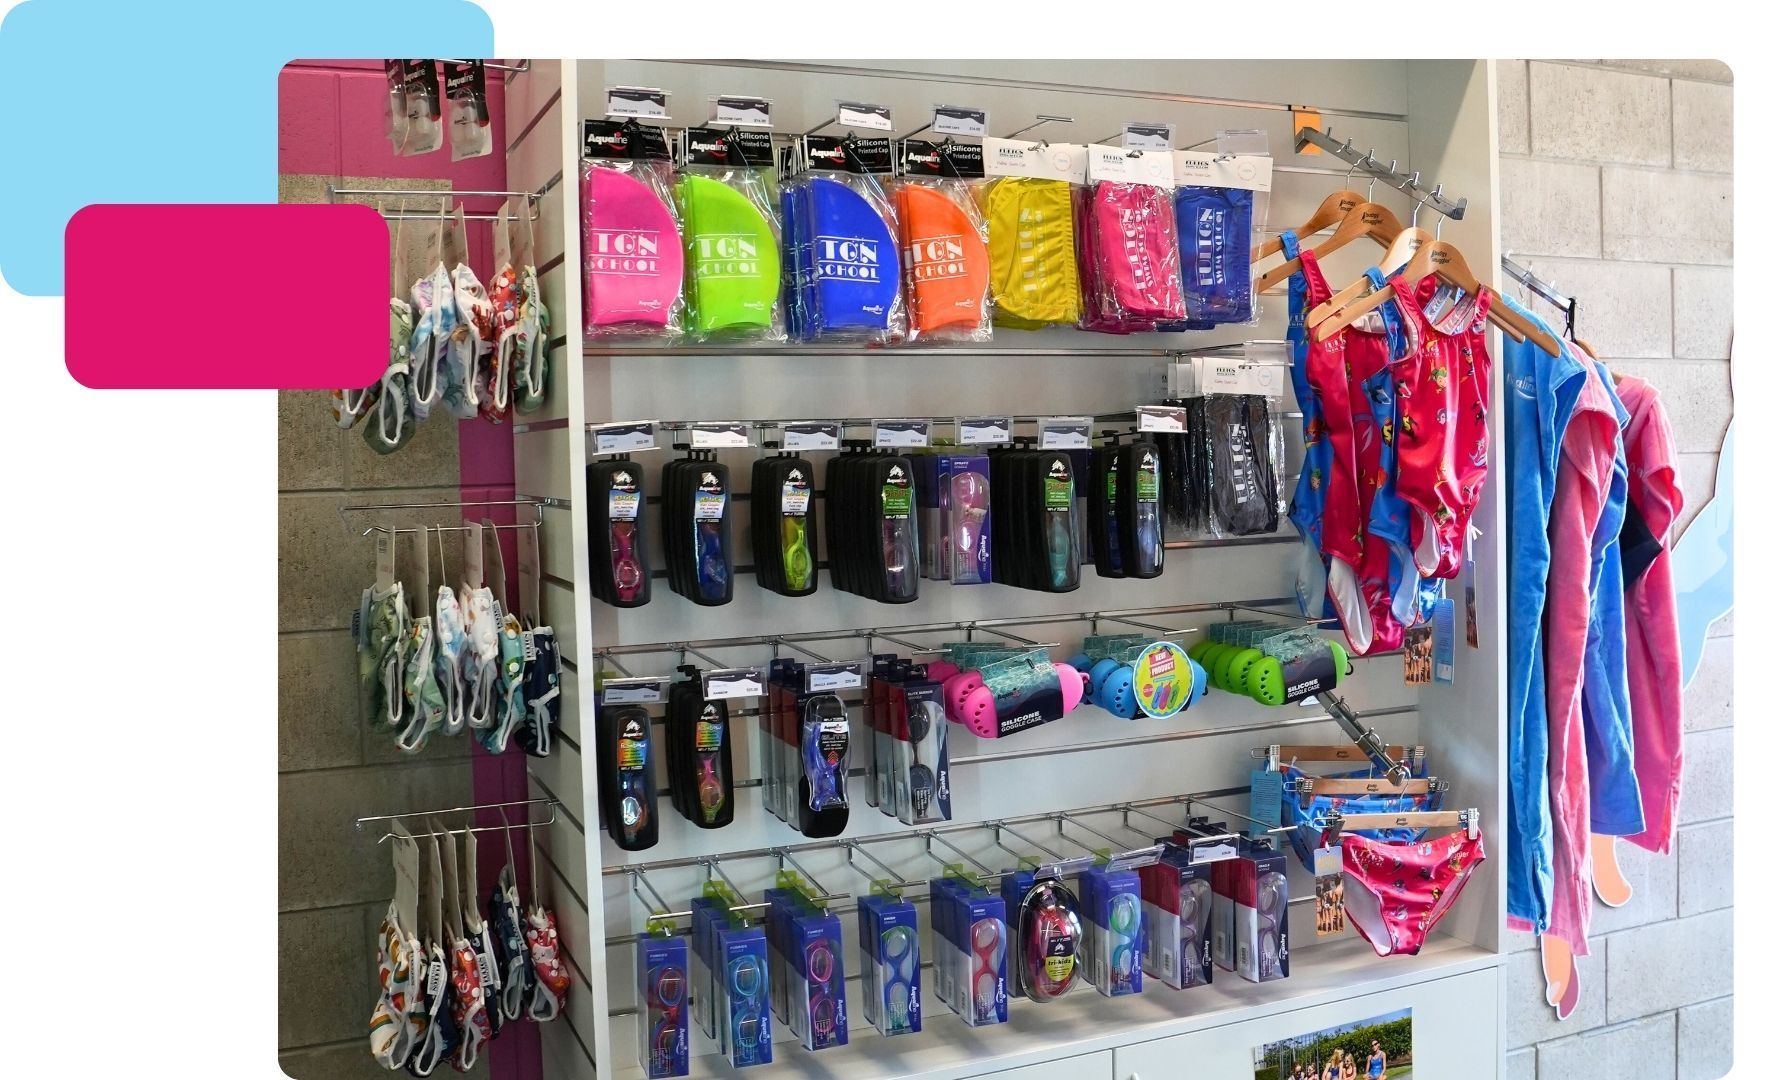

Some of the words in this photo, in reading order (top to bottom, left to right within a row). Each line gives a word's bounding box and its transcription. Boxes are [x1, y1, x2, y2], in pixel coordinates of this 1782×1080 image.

[588, 132, 627, 144] Aqualine
[690, 138, 727, 152] Aqualine
[1199, 208, 1213, 286] FULTON
[818, 264, 880, 279] SCHOOL
[1215, 255, 1224, 285] SWIM
[1152, 662, 1173, 676] PRODUCT
[1287, 679, 1318, 693] SILICONE
[1288, 687, 1307, 698] GOGGLE
[1307, 684, 1320, 692] CASE
[1001, 711, 1040, 727] SILICONE
[1001, 719, 1026, 733] GOGGLE
[1026, 715, 1042, 725] CASE
[940, 770, 949, 800] Aqualine
